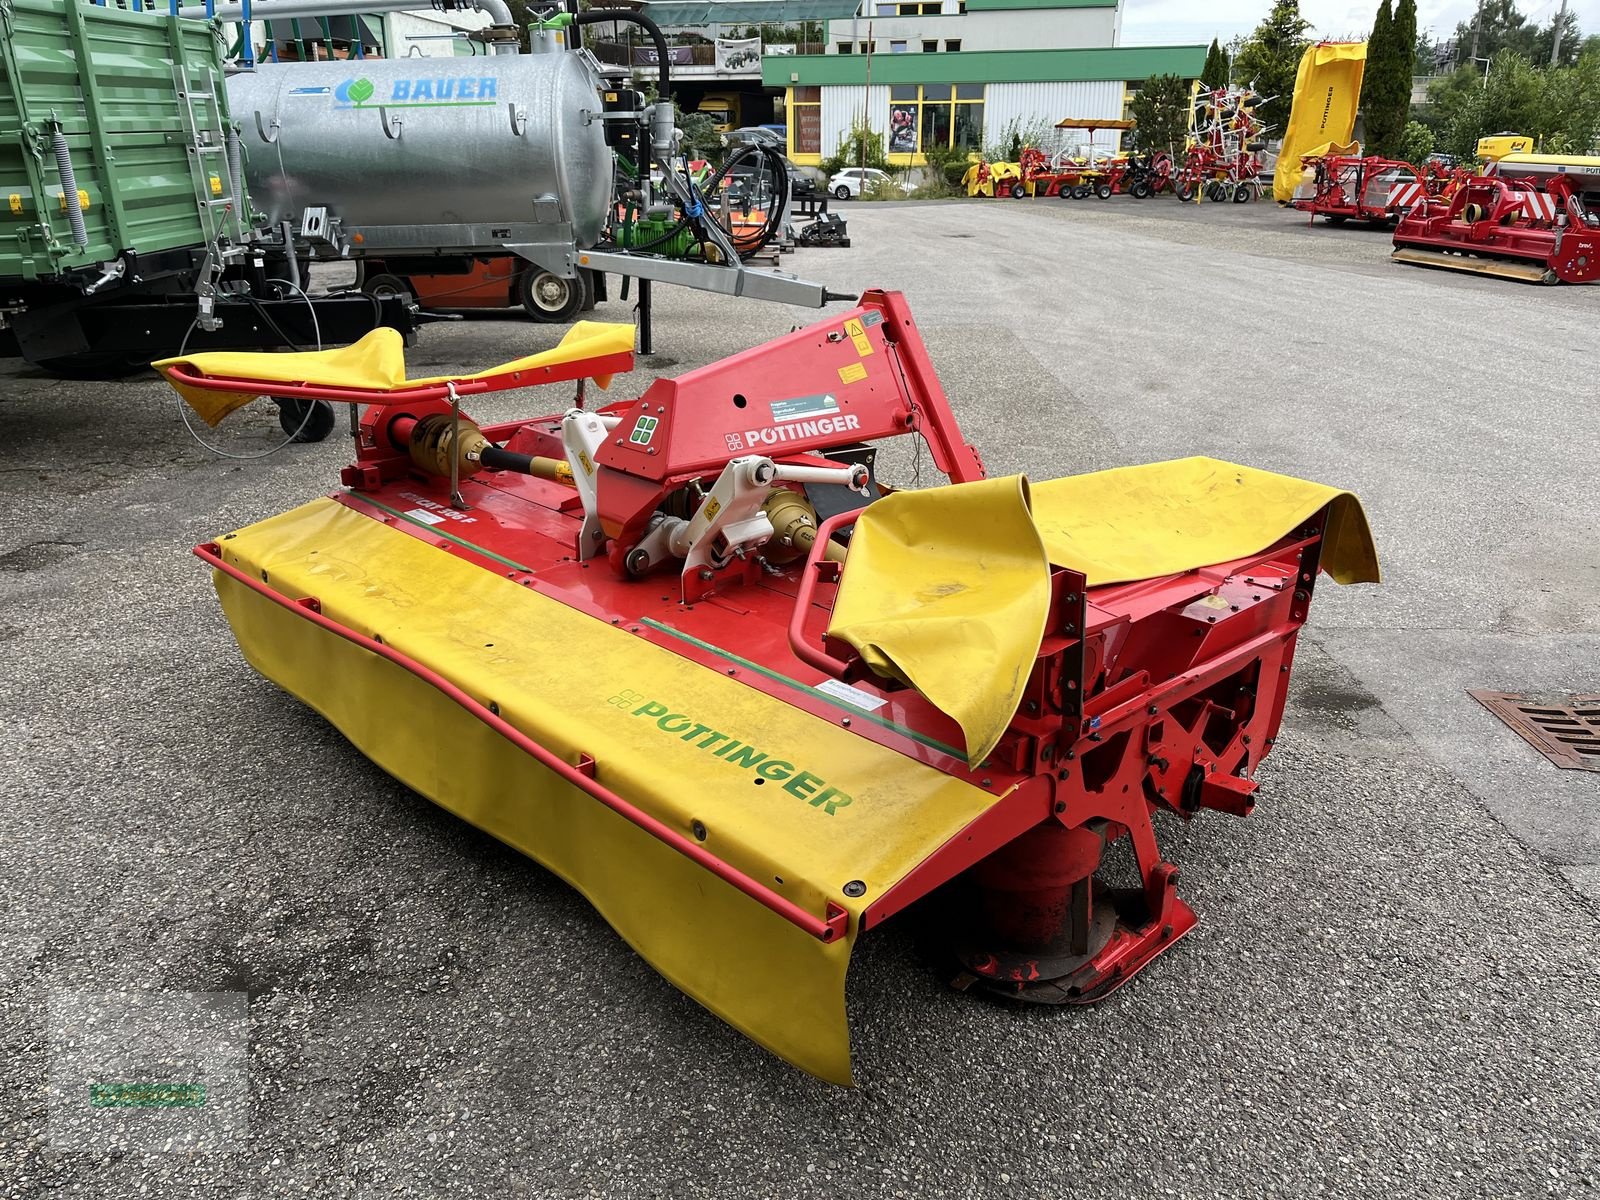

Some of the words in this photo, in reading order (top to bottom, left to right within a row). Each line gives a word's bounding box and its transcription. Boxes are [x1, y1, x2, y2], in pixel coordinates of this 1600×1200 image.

[391, 77, 496, 101] BAUER
[744, 414, 861, 448] PÖTTINGER
[631, 700, 854, 817] PÖTTINGER
